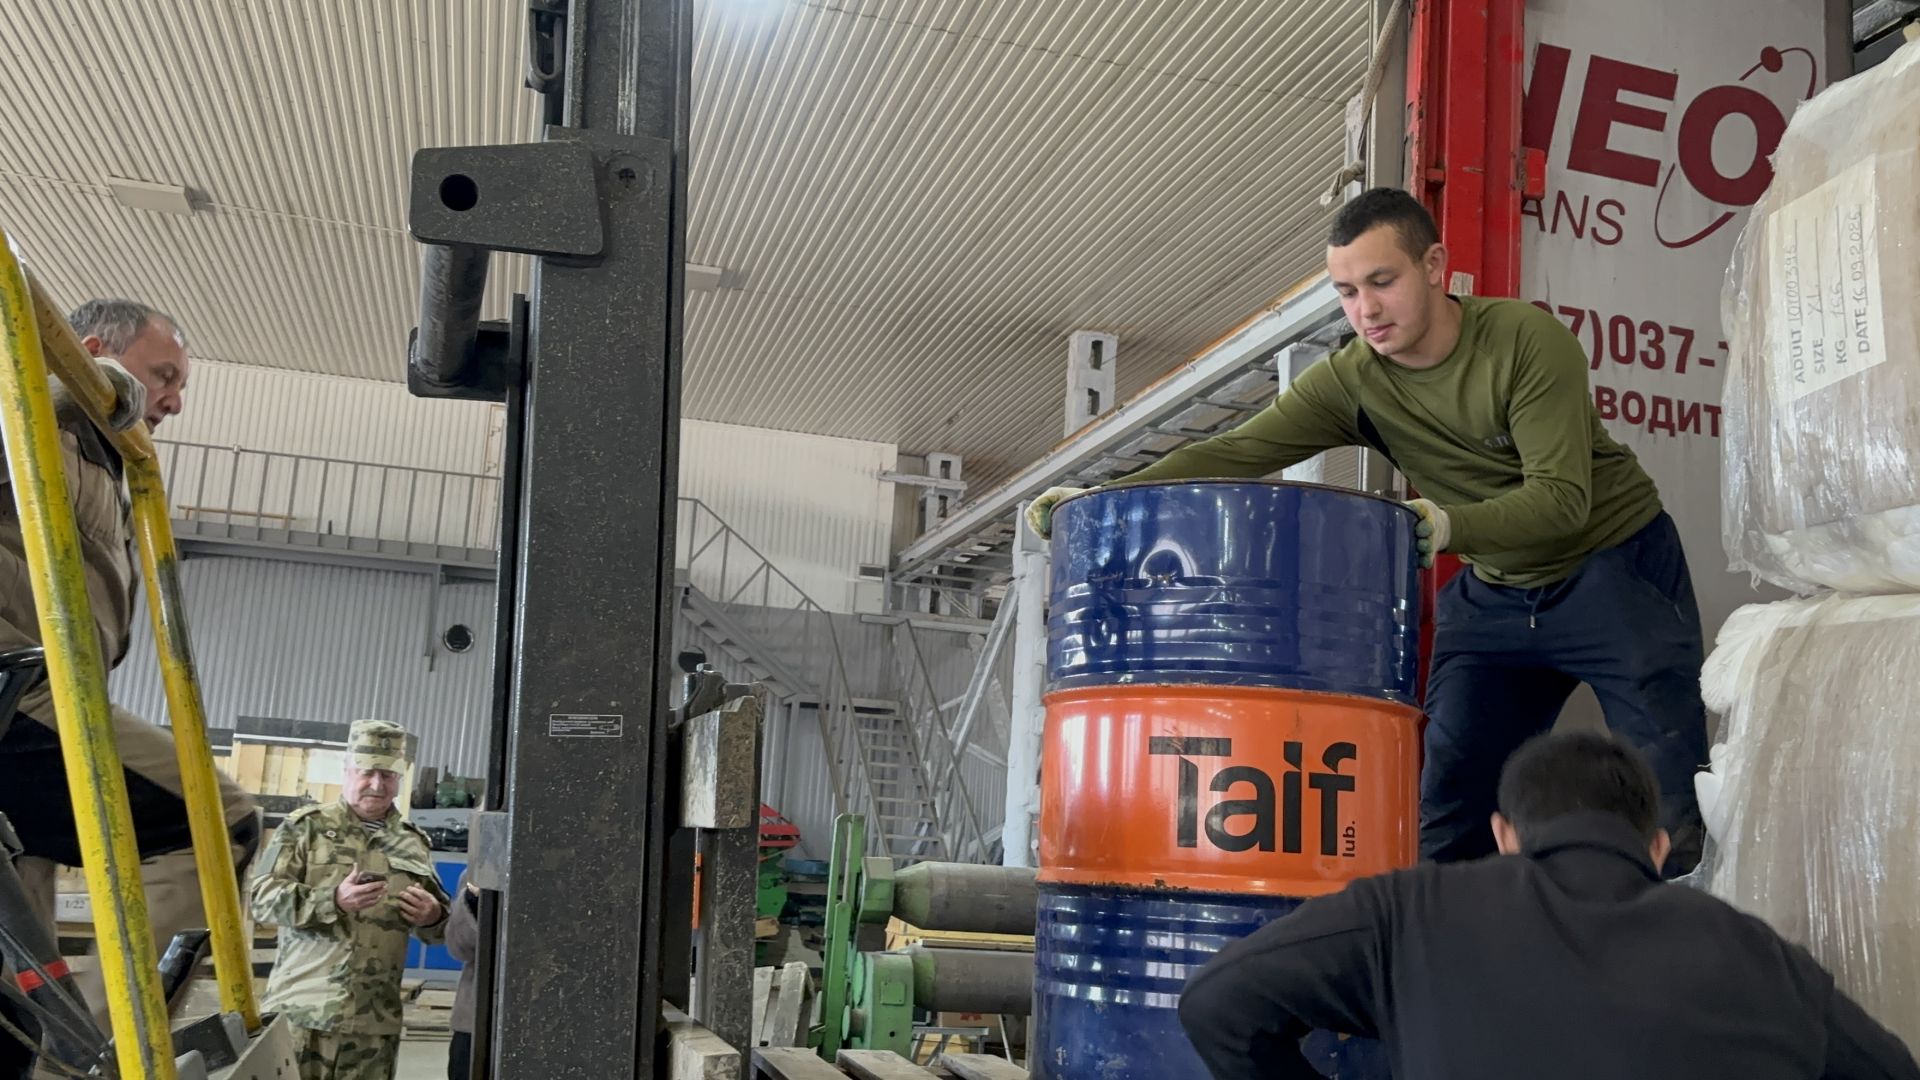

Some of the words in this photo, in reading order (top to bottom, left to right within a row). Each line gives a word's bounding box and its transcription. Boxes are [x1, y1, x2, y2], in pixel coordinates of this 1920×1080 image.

[1834, 339, 1848, 364] KG
[1854, 306, 1870, 354] DATE
[1791, 328, 1806, 384] ADULT
[1812, 338, 1826, 375] SIZE
[1148, 735, 1357, 857] Taif
[1342, 820, 1356, 858] lub.
